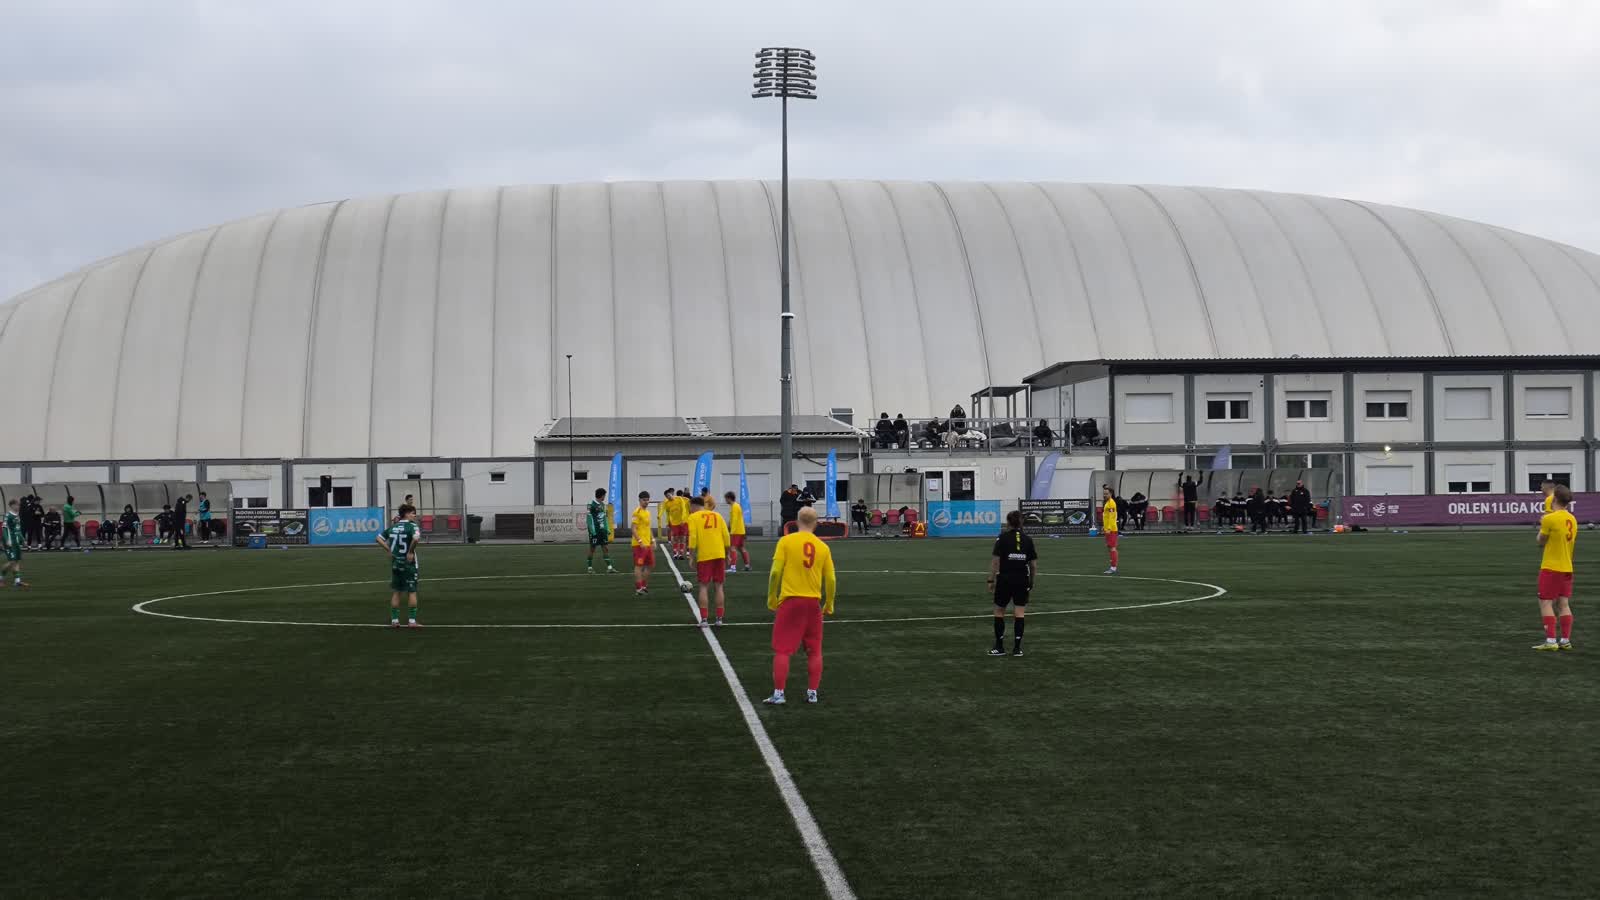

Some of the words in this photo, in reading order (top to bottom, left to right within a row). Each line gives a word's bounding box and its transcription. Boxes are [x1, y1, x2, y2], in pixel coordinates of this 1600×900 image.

[1448, 502, 1490, 514] ORLEN
[1491, 502, 1497, 514] 1
[1499, 502, 1528, 514] LIGA
[335, 518, 380, 533] JAKO
[702, 513, 717, 529] 27
[954, 511, 997, 525] JAKO
[1565, 519, 1574, 542] 3
[389, 534, 408, 554] 75
[802, 542, 816, 569] 9
